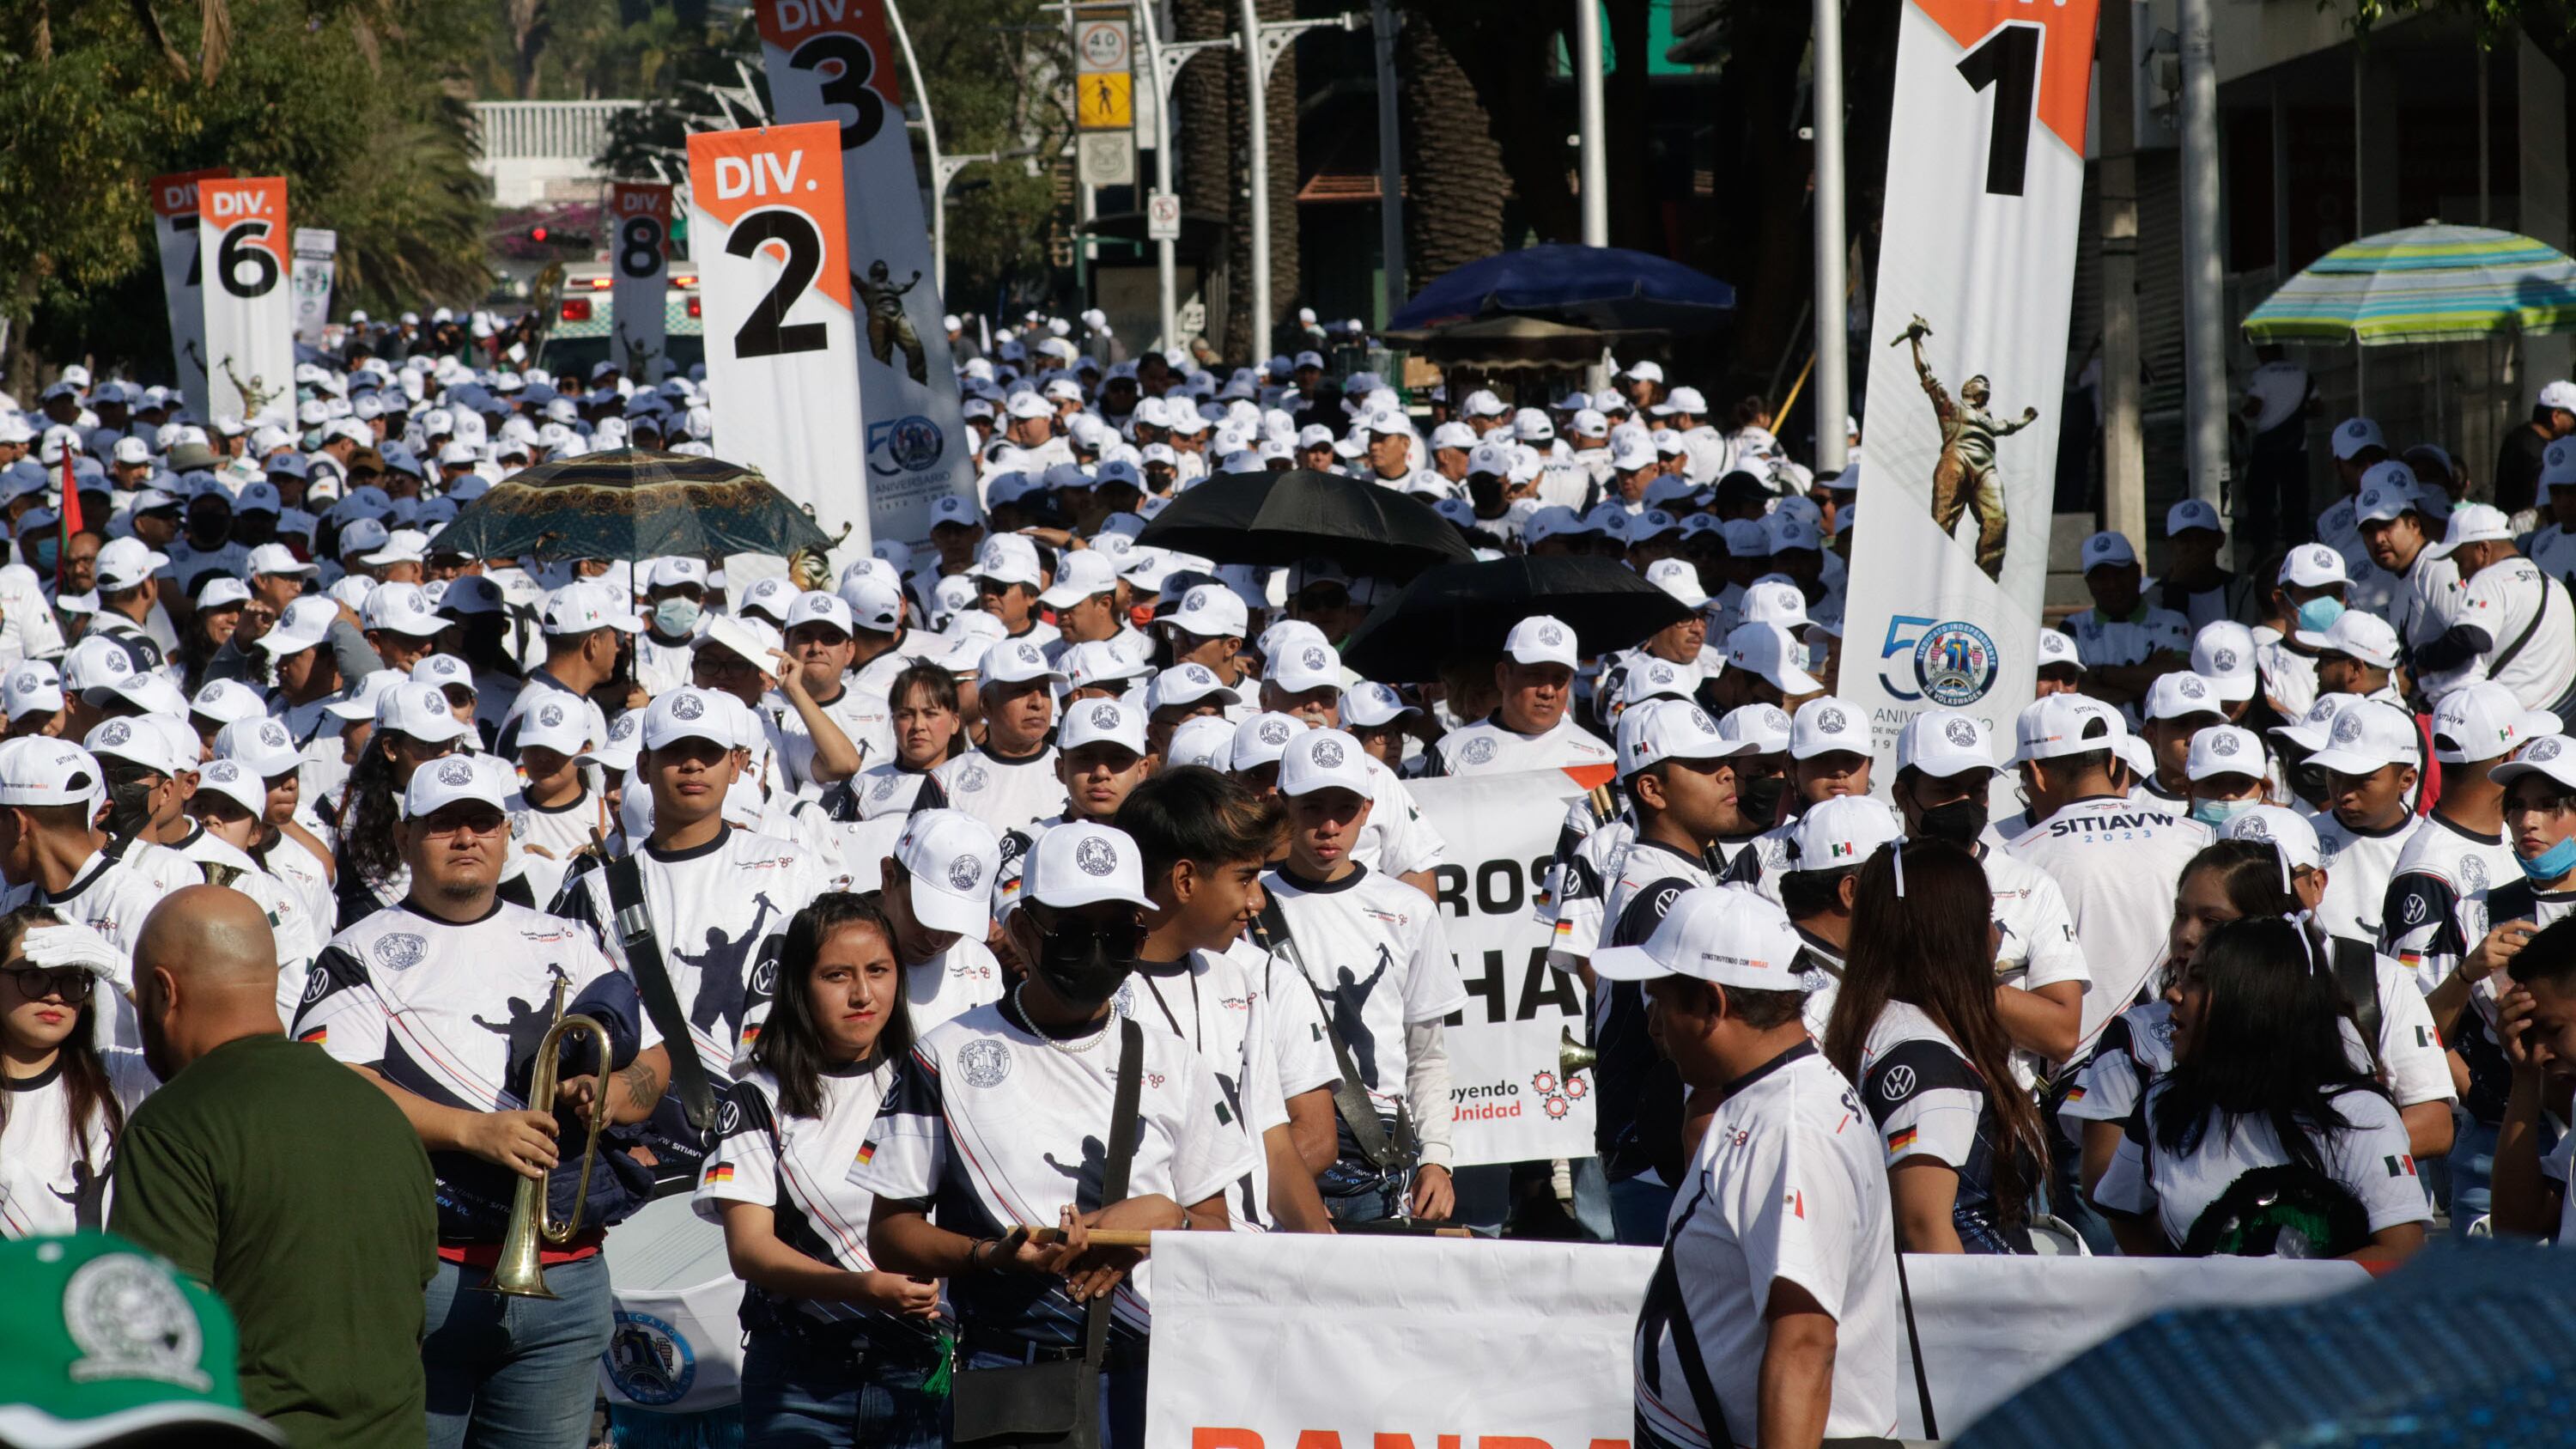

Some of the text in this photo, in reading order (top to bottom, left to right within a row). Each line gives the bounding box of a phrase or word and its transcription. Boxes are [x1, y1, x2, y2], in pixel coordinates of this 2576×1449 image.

[1090, 32, 1116, 46] 40
[789, 35, 884, 150] 3
[1955, 25, 2040, 197] 1
[714, 149, 817, 200] DIV.
[212, 191, 273, 216] DIV.
[623, 192, 663, 211] DIV.
[218, 222, 278, 298] 6
[620, 216, 661, 278] 8
[726, 210, 829, 359] 2
[2050, 813, 2174, 837] SITIAVW
[2085, 830, 2152, 843] 2023
